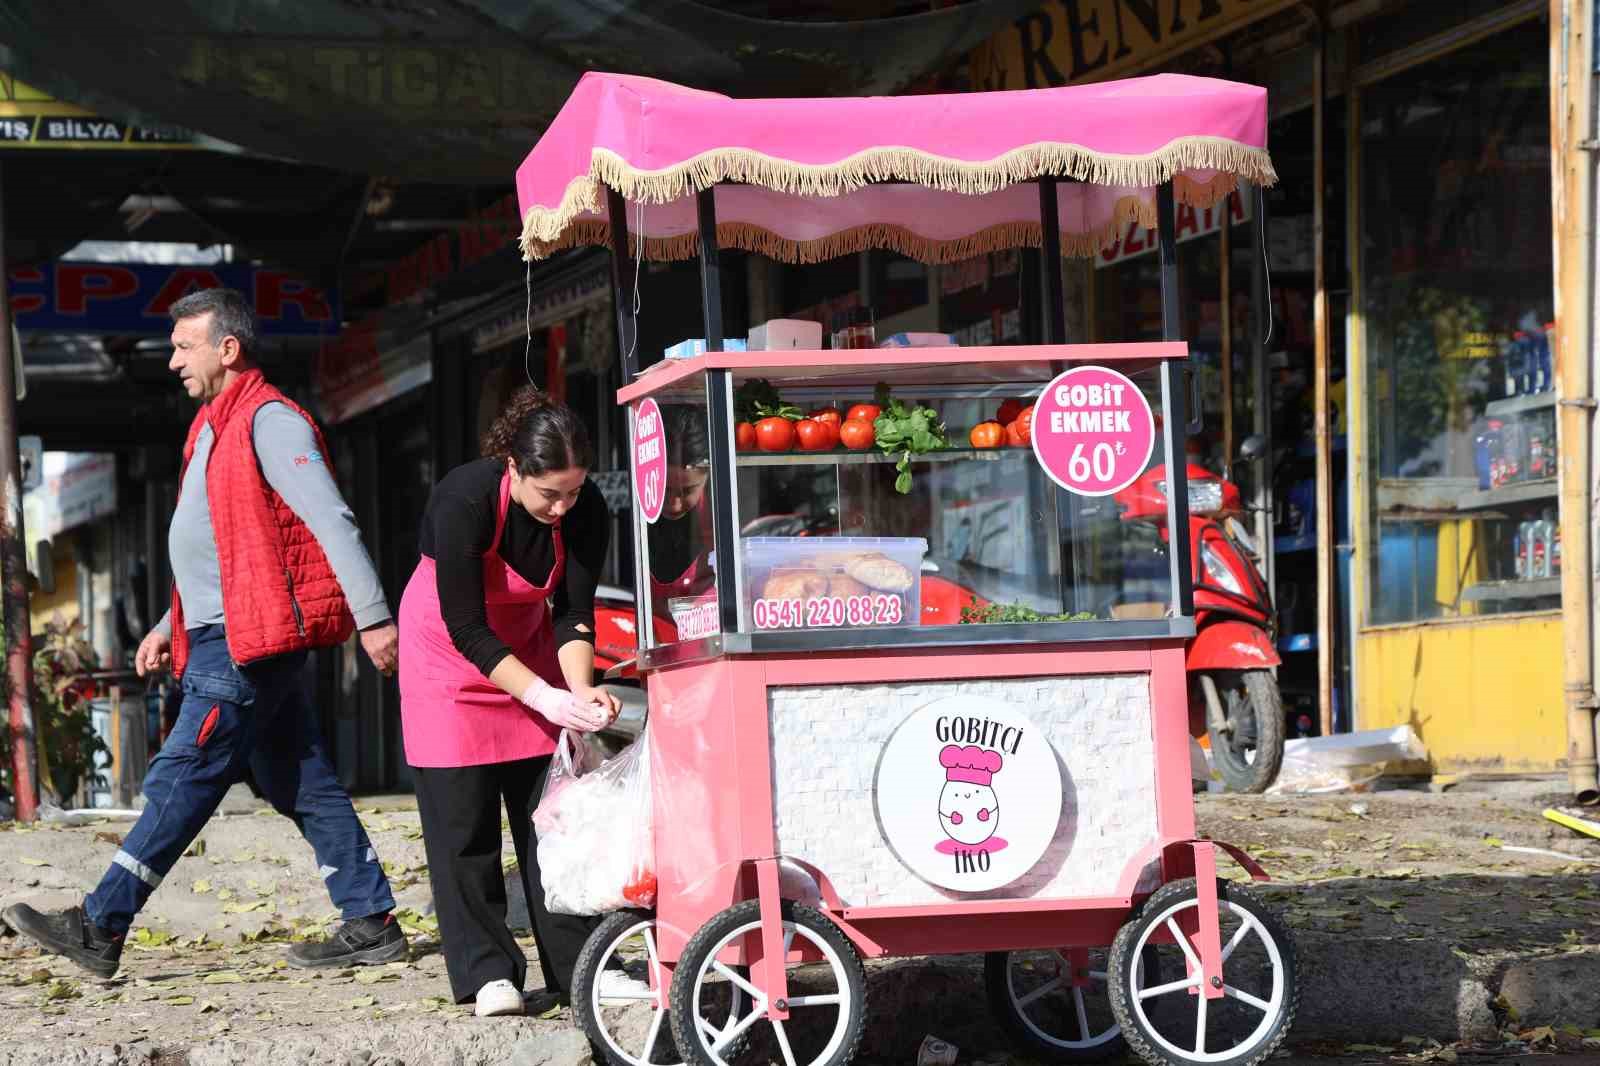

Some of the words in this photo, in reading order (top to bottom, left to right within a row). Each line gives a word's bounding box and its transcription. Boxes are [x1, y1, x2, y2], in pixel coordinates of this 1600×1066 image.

[48, 119, 121, 139] BİLYA
[1050, 410, 1132, 433] EKMEK
[754, 598, 803, 628] 0541
[807, 597, 846, 627] 220
[847, 595, 873, 625] 88
[876, 594, 902, 624] 23
[954, 848, 991, 874] İKO
